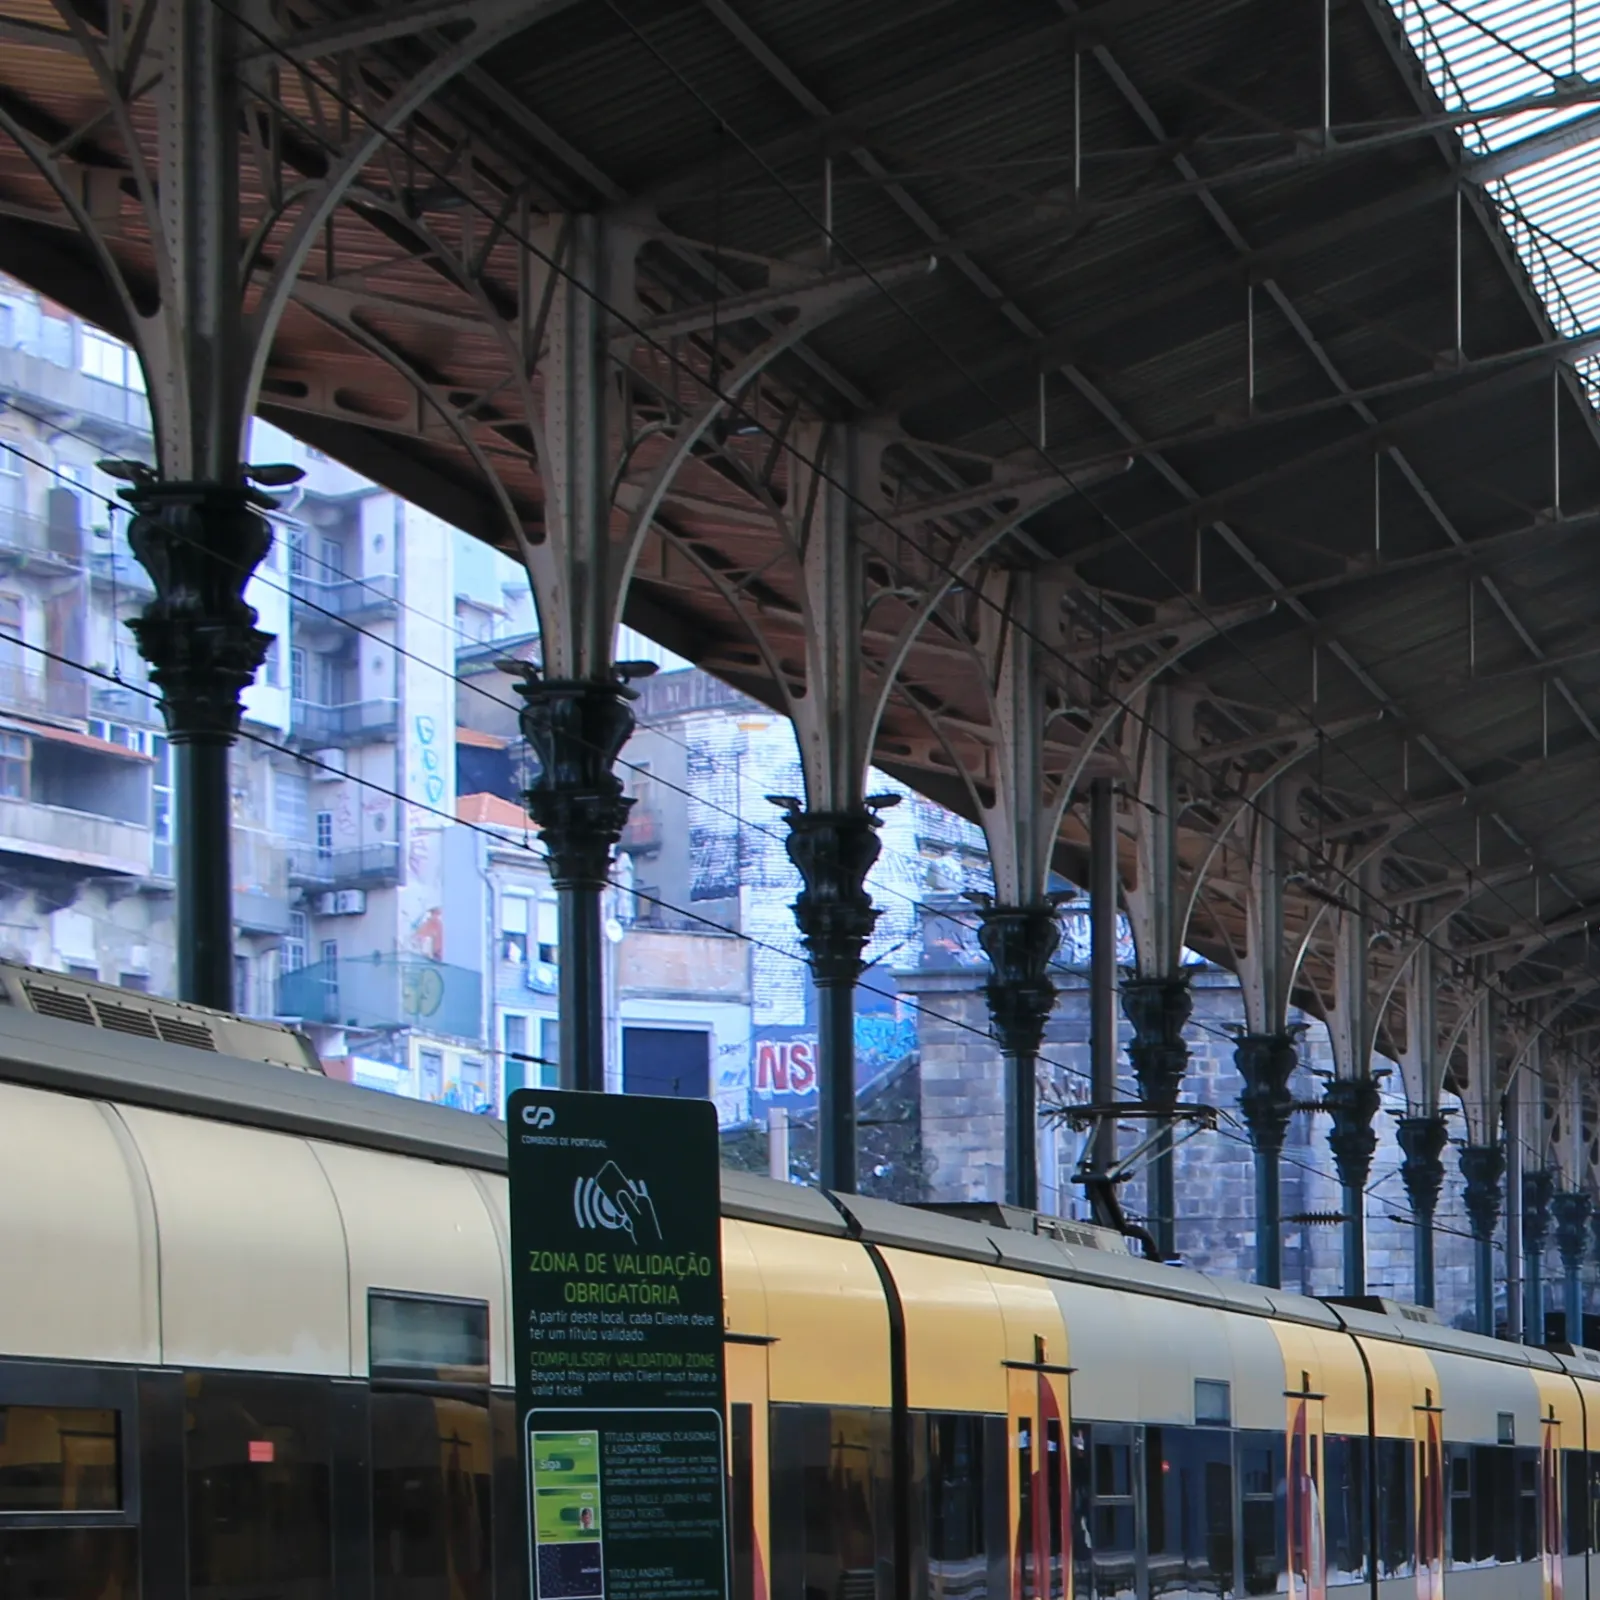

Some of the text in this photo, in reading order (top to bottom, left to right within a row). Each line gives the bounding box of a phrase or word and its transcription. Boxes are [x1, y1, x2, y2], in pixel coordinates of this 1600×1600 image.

[521, 1135, 607, 1148] COMBOIOS DE PORTUGAL
[530, 1251, 711, 1280] ZONA DE VALIDAÇÃO
[564, 1277, 679, 1304] OBRIGATÓRIA
[529, 1310, 715, 1326] A partir deste local, cada Cliente deve
[530, 1328, 545, 1340] ter
[549, 1330, 565, 1340] um
[569, 1327, 596, 1340] título
[530, 1352, 715, 1368] COMPULSORY VALIDATION ZONE
[531, 1370, 717, 1383] Beyond this point each Client must have a
[531, 1386, 553, 1396] valid
